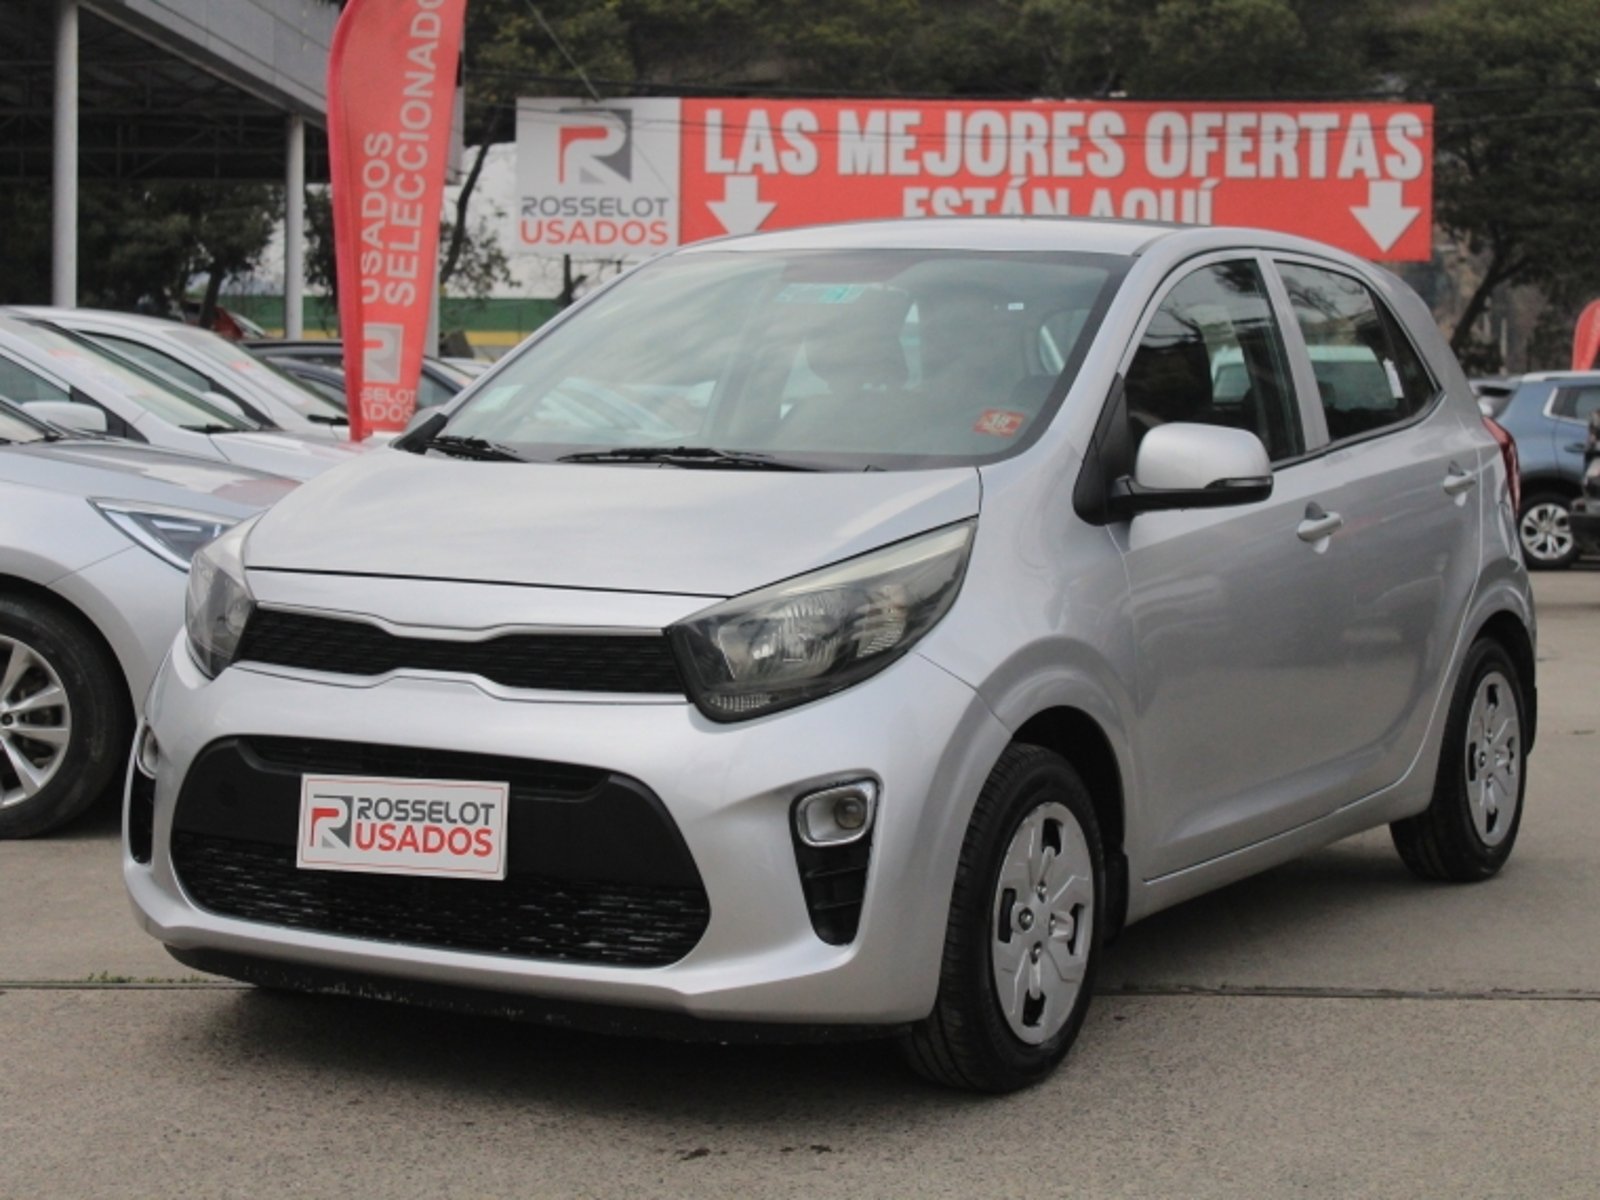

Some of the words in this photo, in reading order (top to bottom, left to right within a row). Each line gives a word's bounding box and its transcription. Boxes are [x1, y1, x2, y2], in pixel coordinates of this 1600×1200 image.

[384, 0, 443, 307] SELECCIONAD
[705, 108, 819, 175] LAS
[837, 109, 1126, 178] MEJORES
[1145, 111, 1424, 181] OFERTAS
[361, 132, 394, 304] USADOS
[521, 196, 668, 218] ROSSELOT
[520, 220, 669, 246] USADOS
[357, 797, 495, 826] ROSSELOT
[355, 822, 493, 857] USADOS
